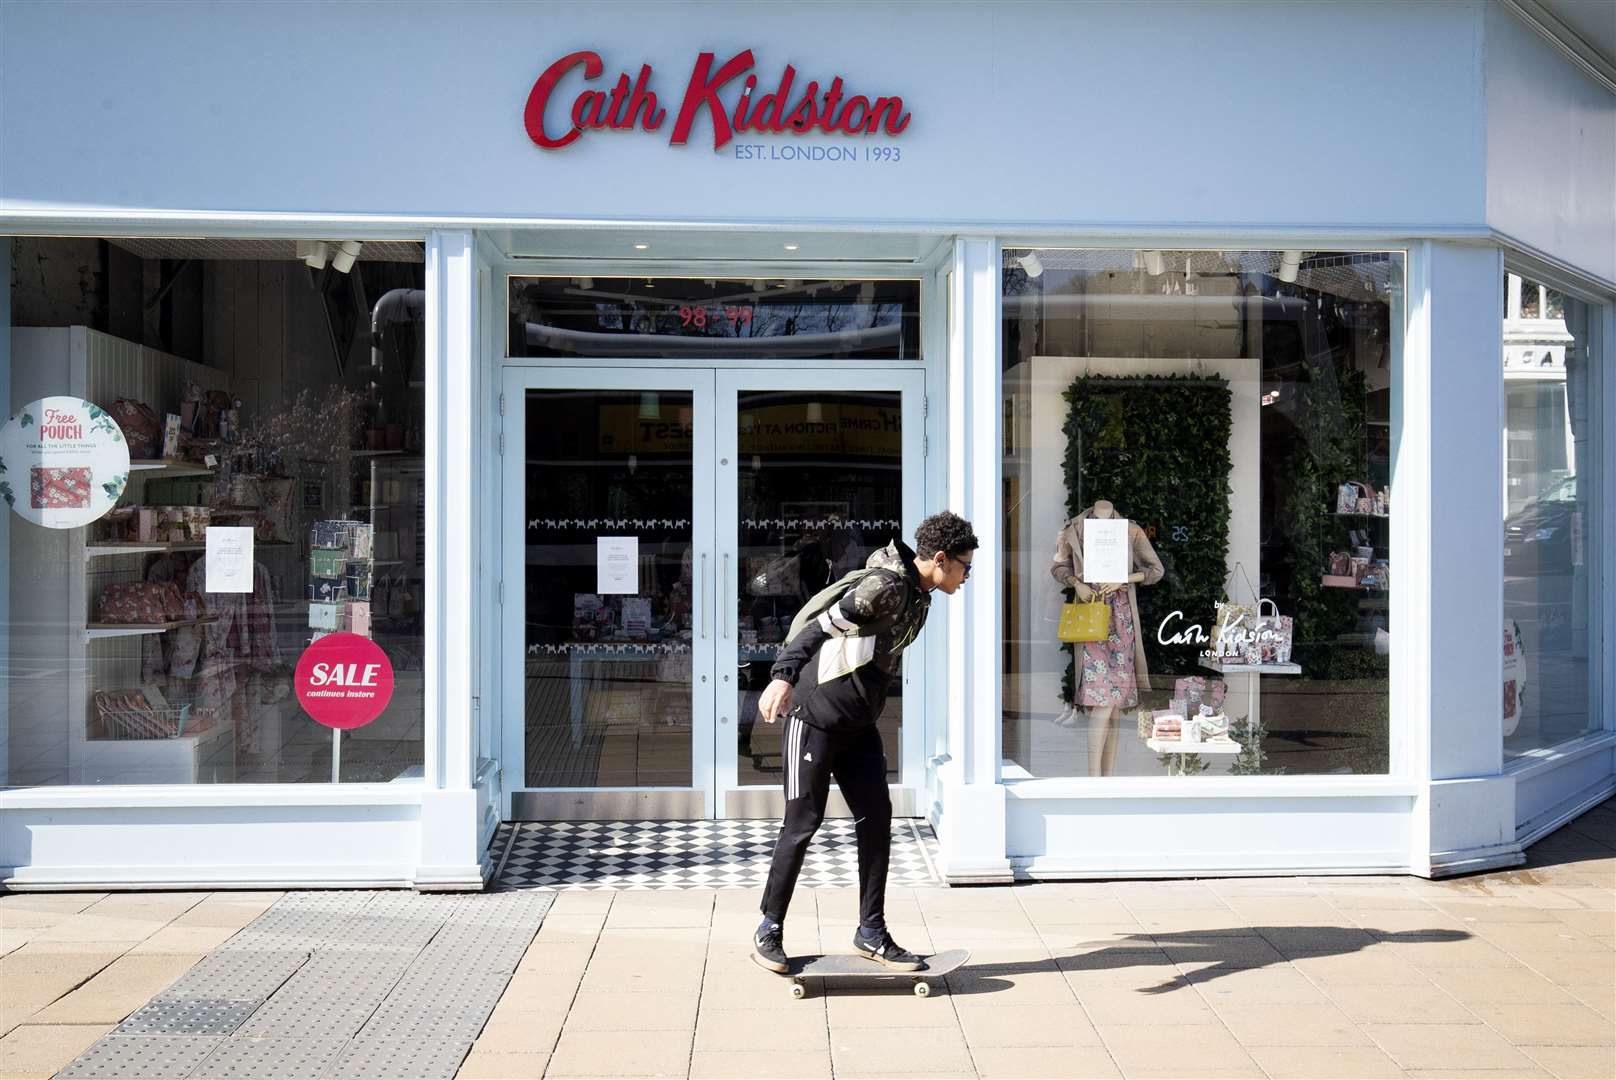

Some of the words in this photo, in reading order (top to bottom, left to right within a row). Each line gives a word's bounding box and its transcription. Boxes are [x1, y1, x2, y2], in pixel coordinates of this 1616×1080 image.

[524, 50, 666, 150] Cath
[669, 49, 911, 151] Kidston
[735, 144, 768, 160] EST.
[771, 145, 857, 161] LONDON
[864, 147, 901, 162] 1993
[45, 409, 77, 425] Free
[40, 424, 82, 441] POUCH
[1157, 610, 1209, 645] Cath
[1217, 612, 1283, 645] Kidston
[310, 662, 381, 687] SALE
[306, 690, 345, 698] continues
[347, 689, 376, 698] instore
